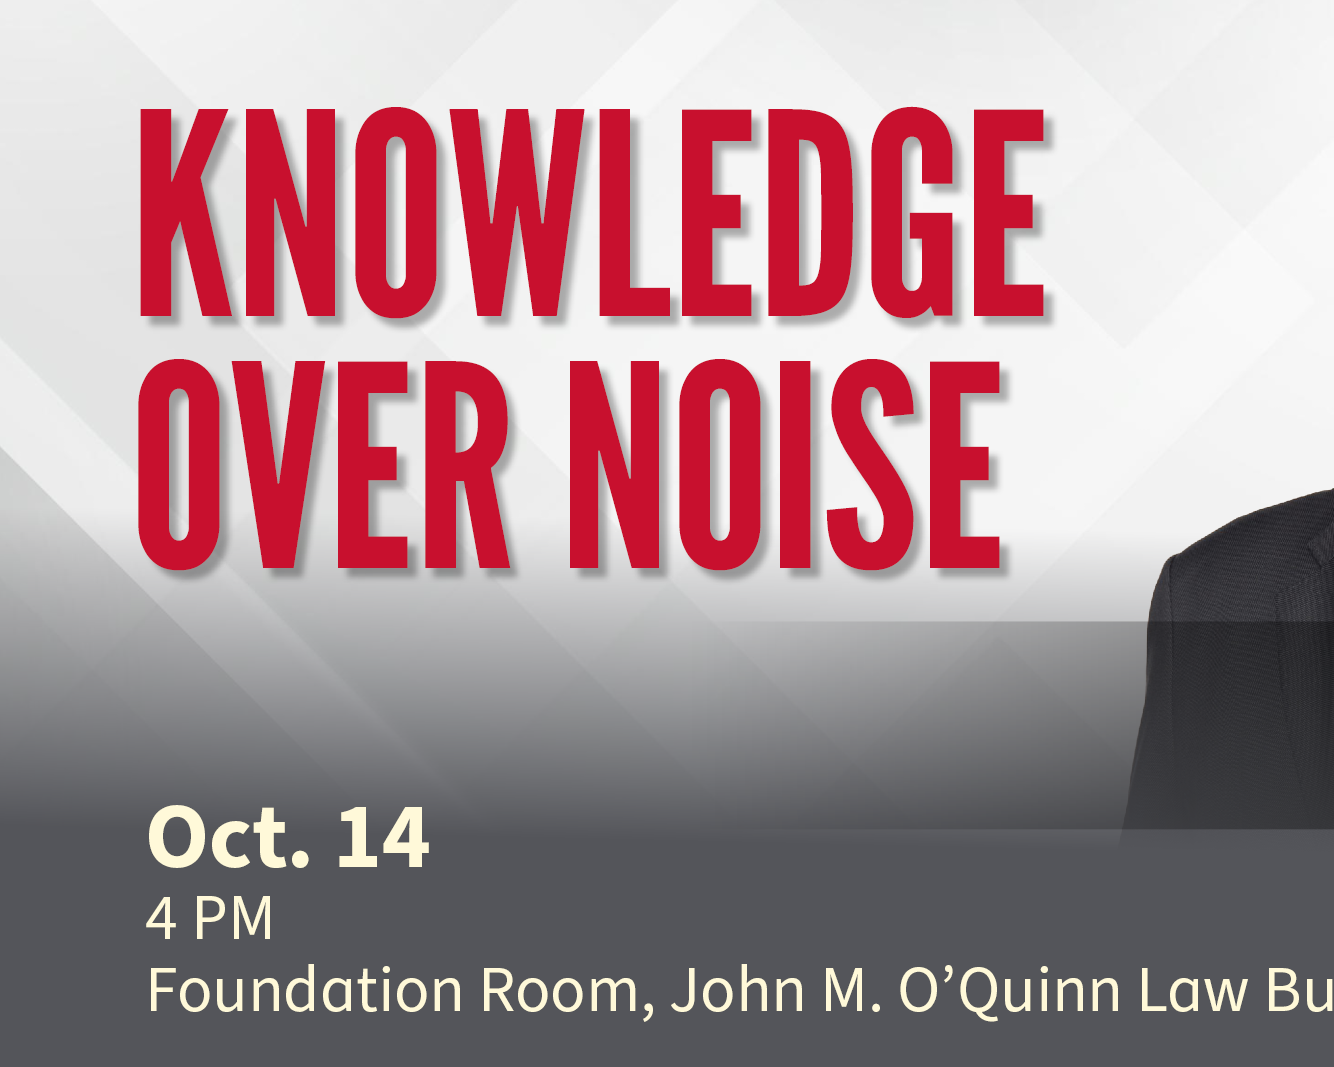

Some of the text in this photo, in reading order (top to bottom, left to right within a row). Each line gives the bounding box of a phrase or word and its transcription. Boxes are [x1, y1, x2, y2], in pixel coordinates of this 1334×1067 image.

[140, 106, 1044, 319] KNOWLEDGE
[138, 358, 1000, 571] OVER NOISE
[148, 804, 430, 869] Oct. 14
[145, 895, 271, 940] 4 PM
[150, 963, 461, 1013] Foundation
[483, 967, 654, 1023] Room,
[670, 963, 803, 1013] John
[825, 967, 881, 1013] M.
[900, 964, 1119, 1022] O’Quinn
[1141, 967, 1249, 1013] Law
